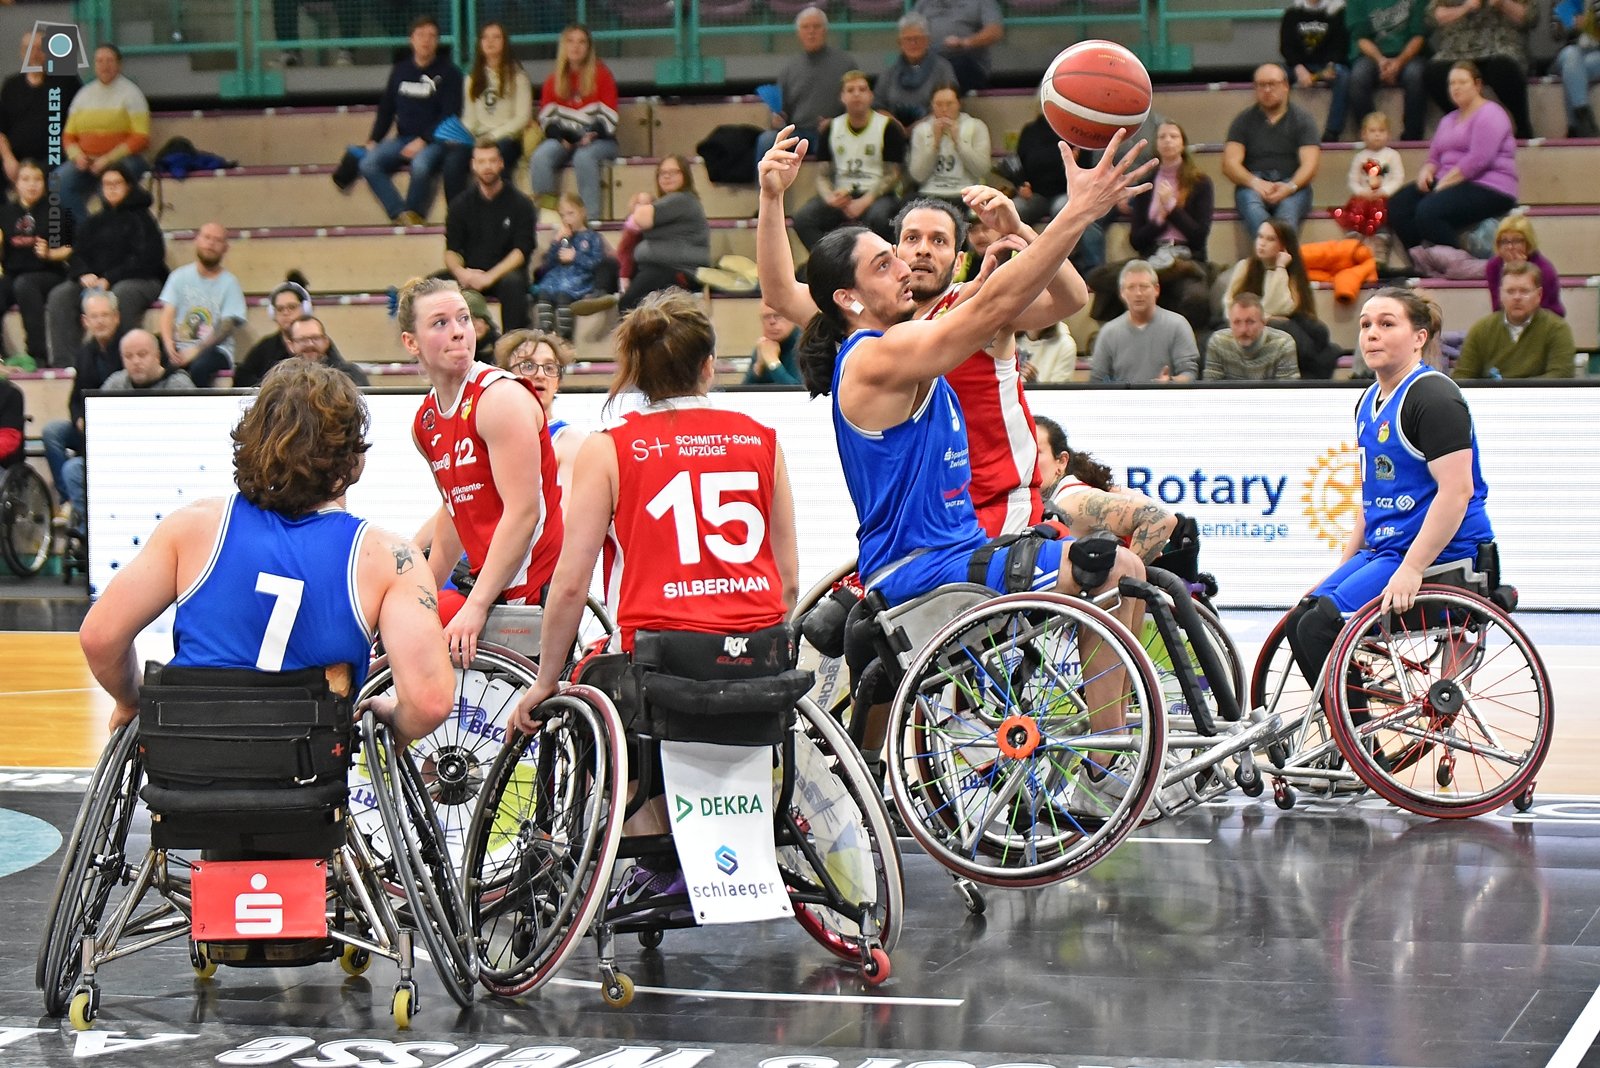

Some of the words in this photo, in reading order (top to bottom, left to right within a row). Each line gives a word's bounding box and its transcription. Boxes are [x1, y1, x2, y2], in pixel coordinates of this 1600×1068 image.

[678, 446, 727, 457] AUFZÜGE
[1127, 466, 1288, 515] Rotary
[1375, 496, 1394, 509] GGZ
[645, 470, 766, 566] 15
[1199, 519, 1289, 542] emitage
[663, 576, 770, 598] SILBERMAN
[255, 571, 304, 672] 7
[700, 794, 763, 816] DEKRA
[693, 881, 775, 899] schlaeger
